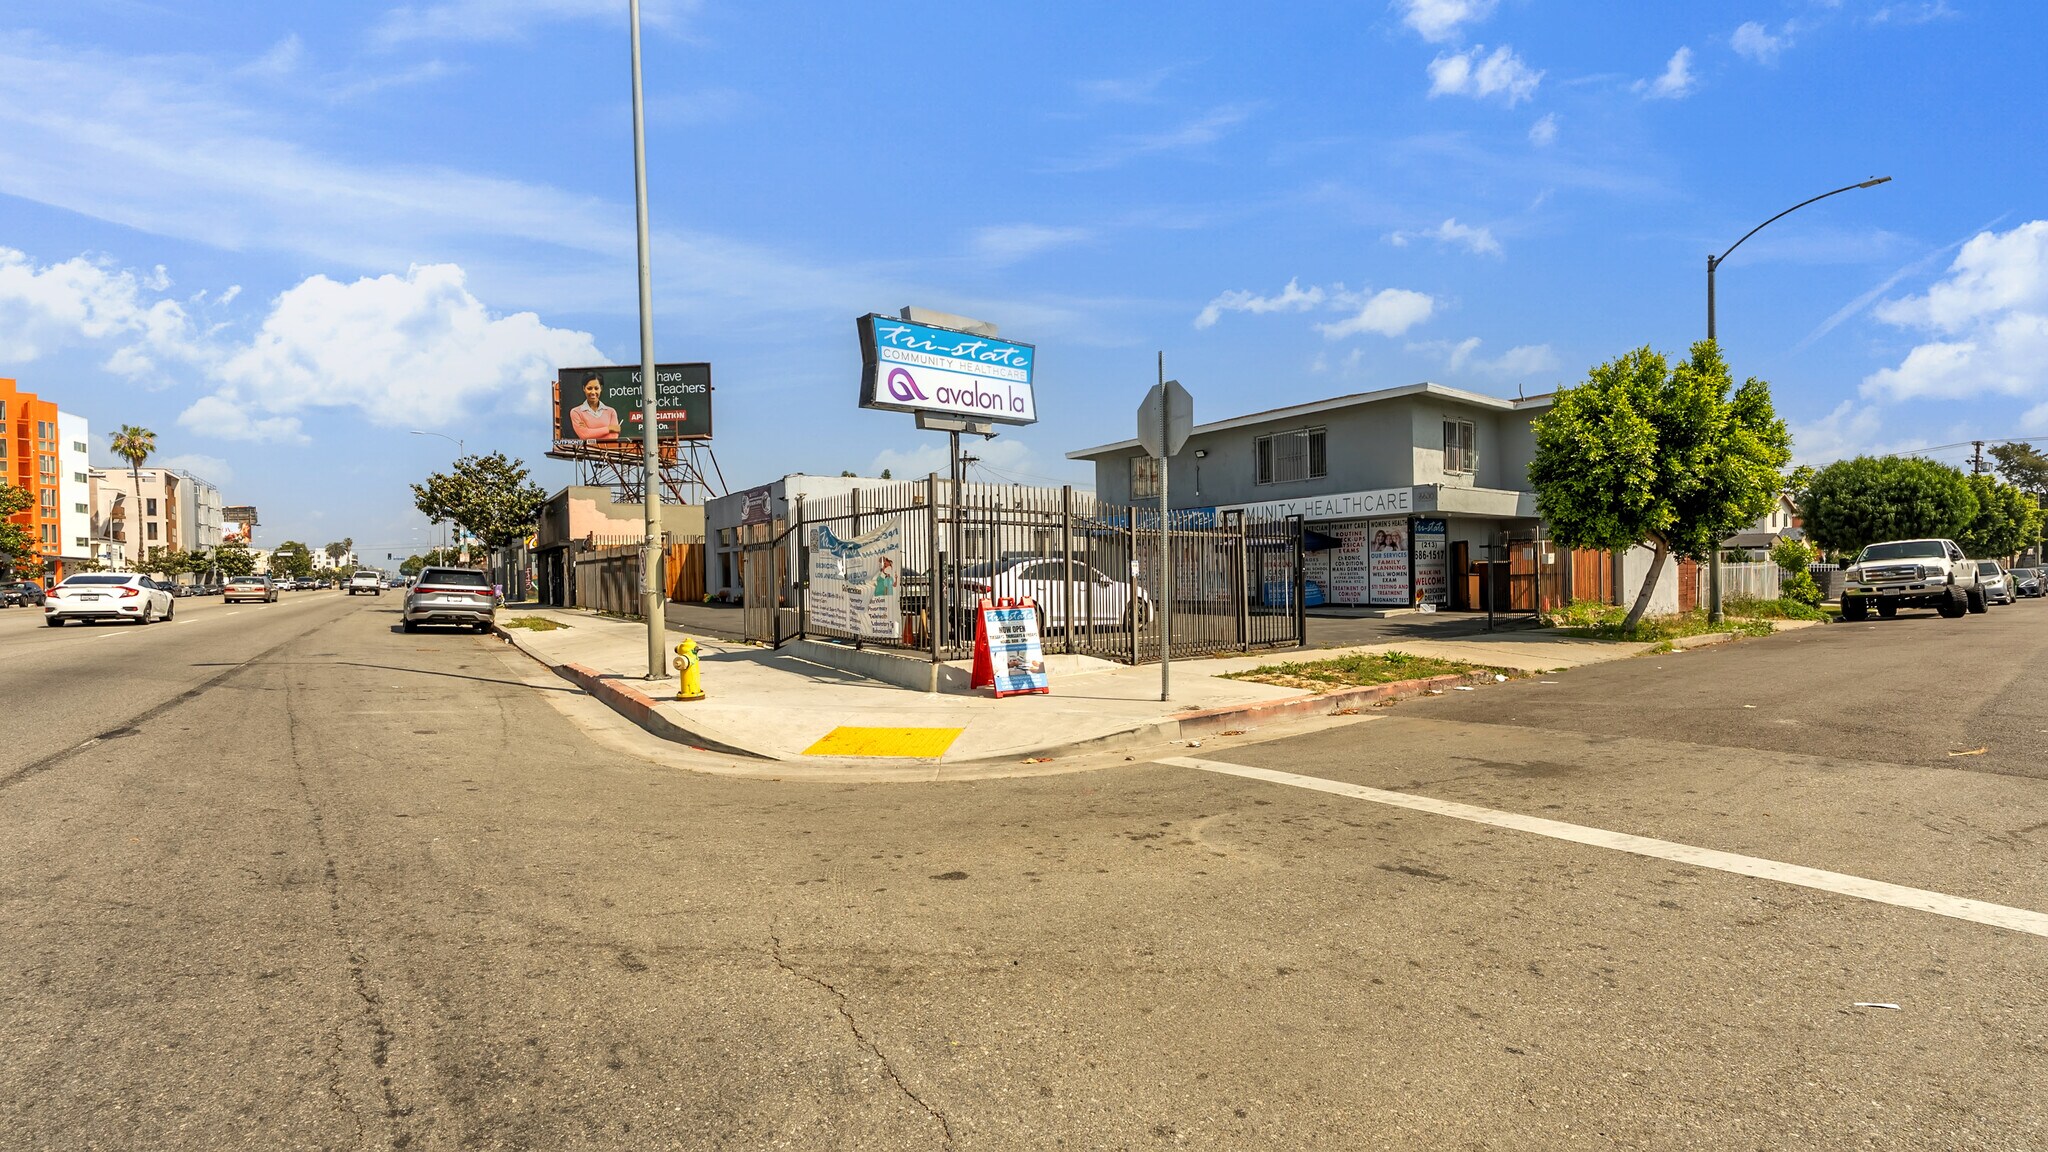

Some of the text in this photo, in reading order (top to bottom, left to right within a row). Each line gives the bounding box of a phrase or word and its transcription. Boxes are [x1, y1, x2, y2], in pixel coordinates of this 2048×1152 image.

[879, 325, 1028, 367] tri-state
[883, 348, 1026, 380] COMMUNITY HEALTHCARE
[656, 371, 682, 382] have
[657, 382, 706, 394] Teachers
[635, 395, 682, 408] uck it.
[936, 380, 1024, 413] avalon la
[631, 412, 685, 420] APCIATION
[1219, 503, 1296, 524] COMUNITY
[1304, 492, 1408, 516] HEALTHCARE
[1421, 541, 1438, 549] (213)
[1416, 577, 1445, 585] WELCOME
[999, 626, 1011, 634] NOW
